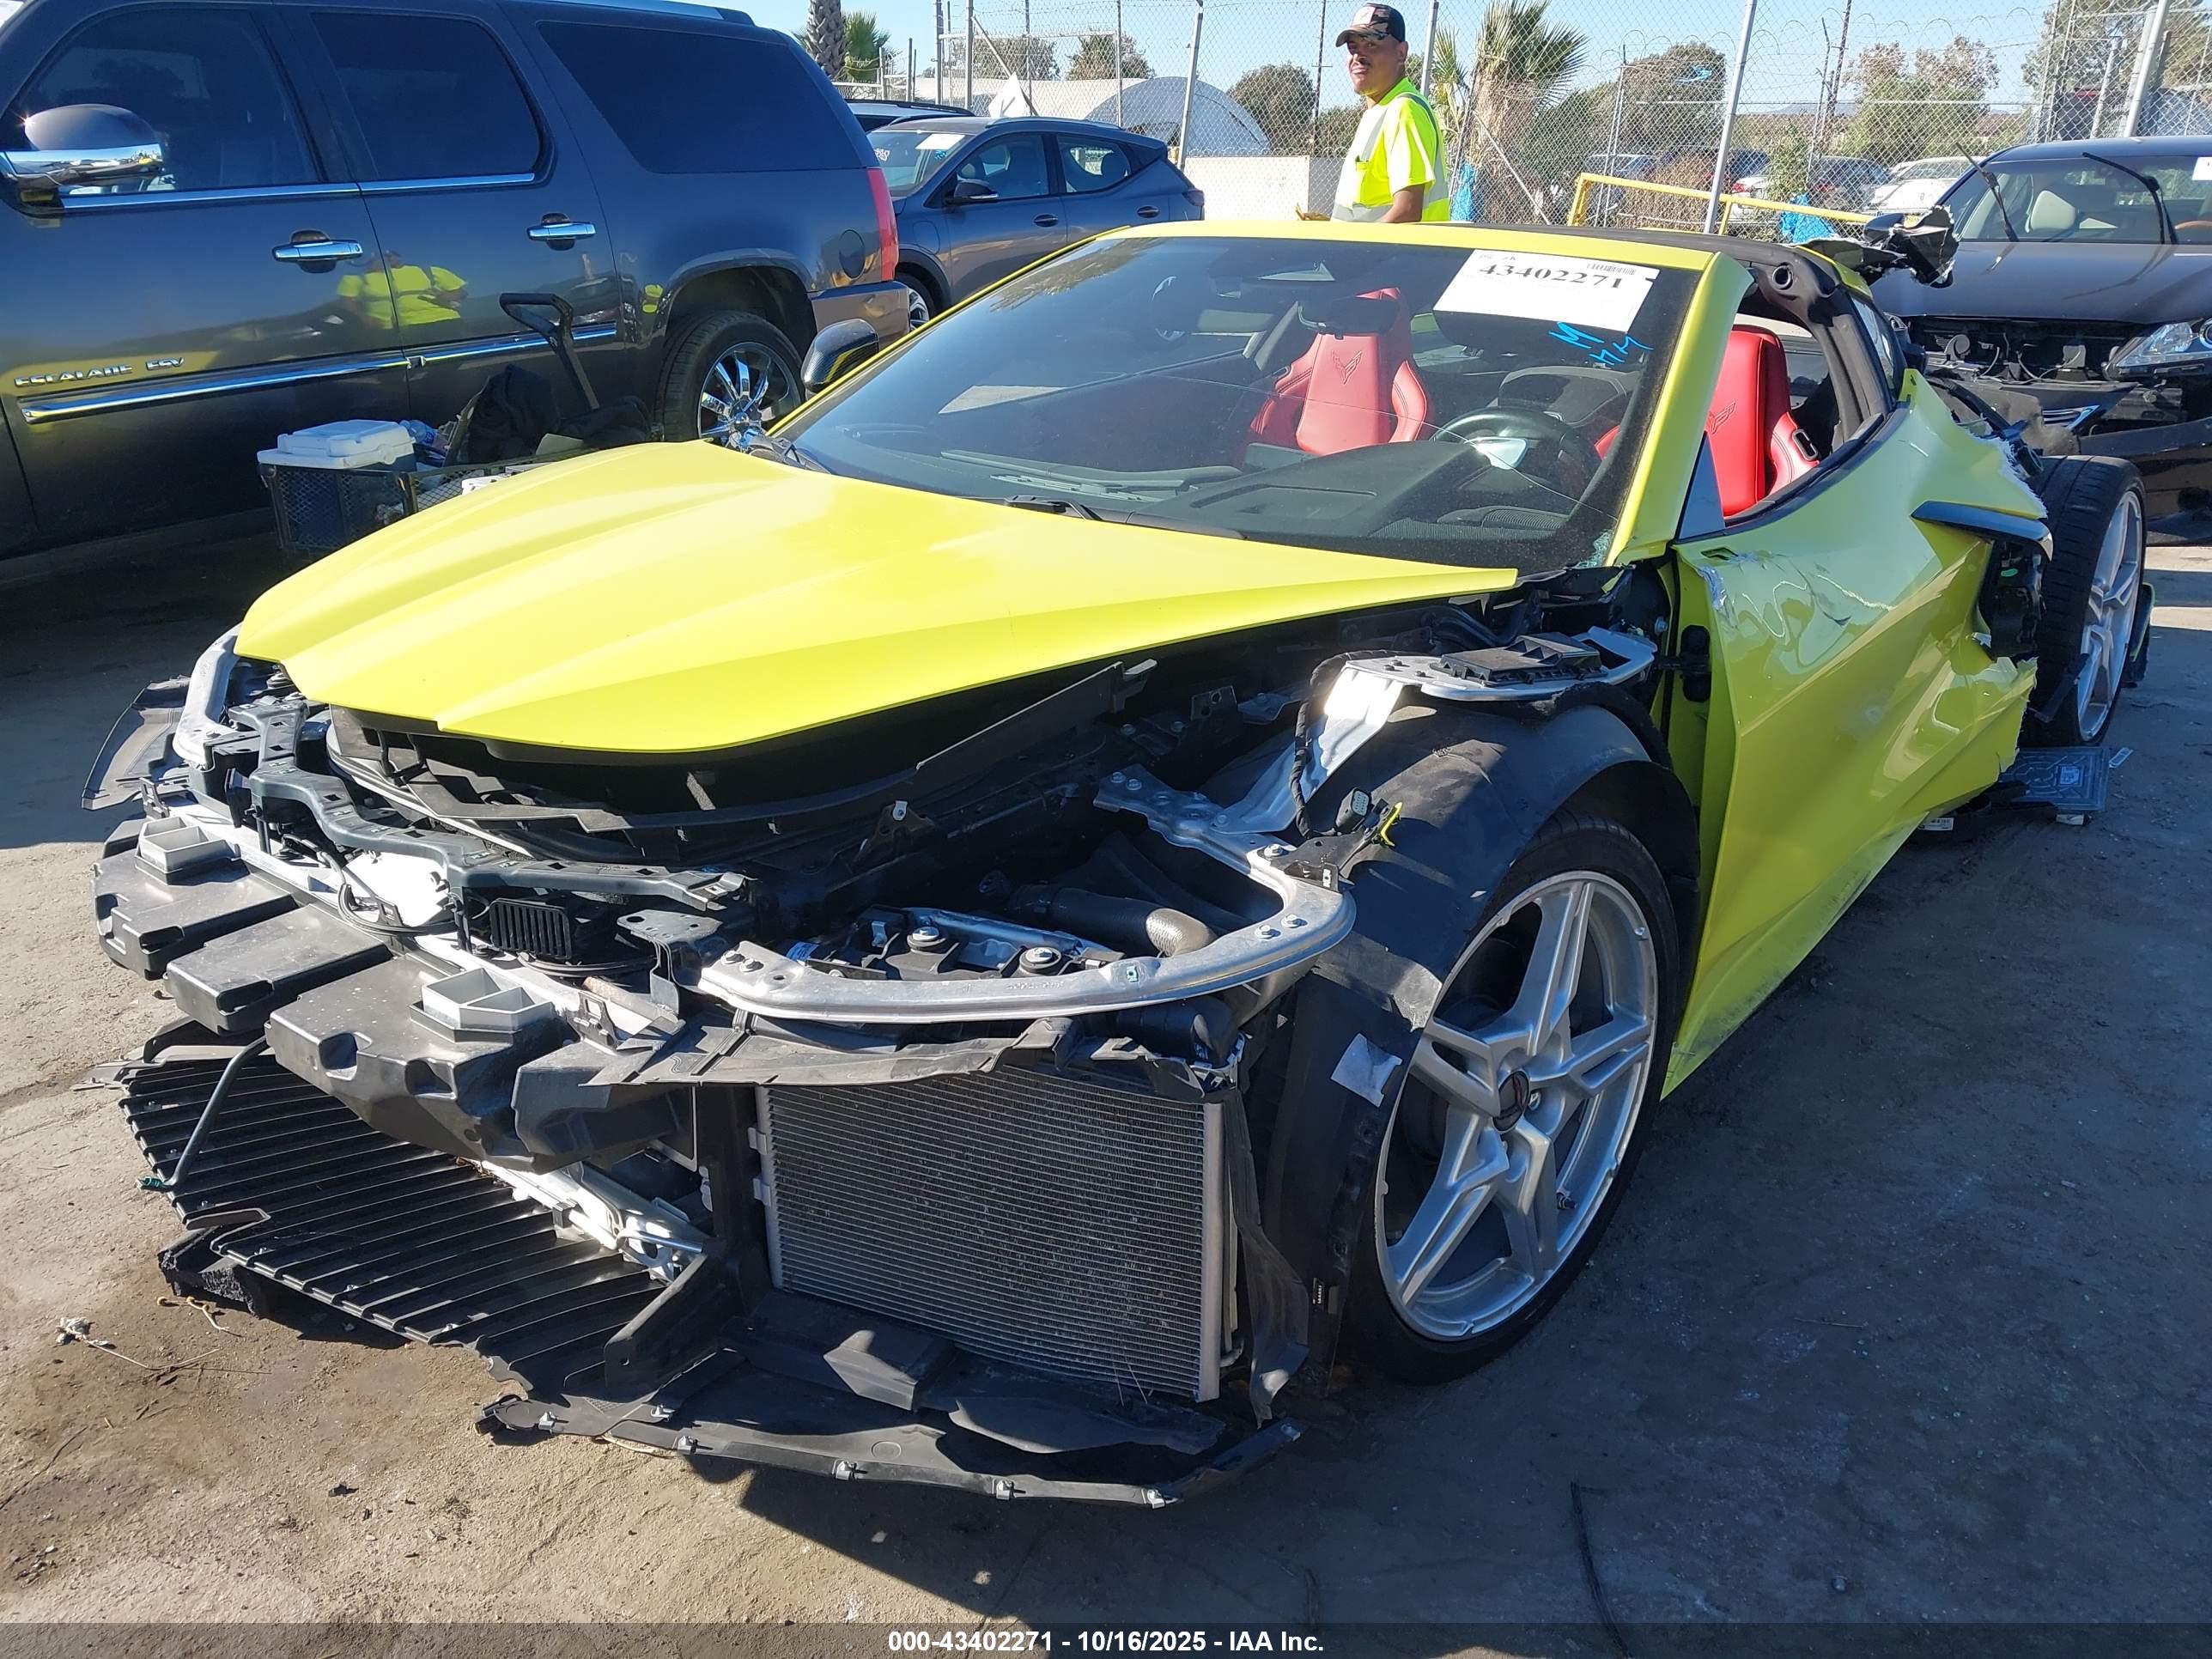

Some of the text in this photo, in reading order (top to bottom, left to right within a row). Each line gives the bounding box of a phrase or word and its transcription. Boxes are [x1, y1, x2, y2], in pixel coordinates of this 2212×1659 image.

[1479, 264, 1624, 289] 43402271
[13, 357, 185, 388] ESCALADE ESV
